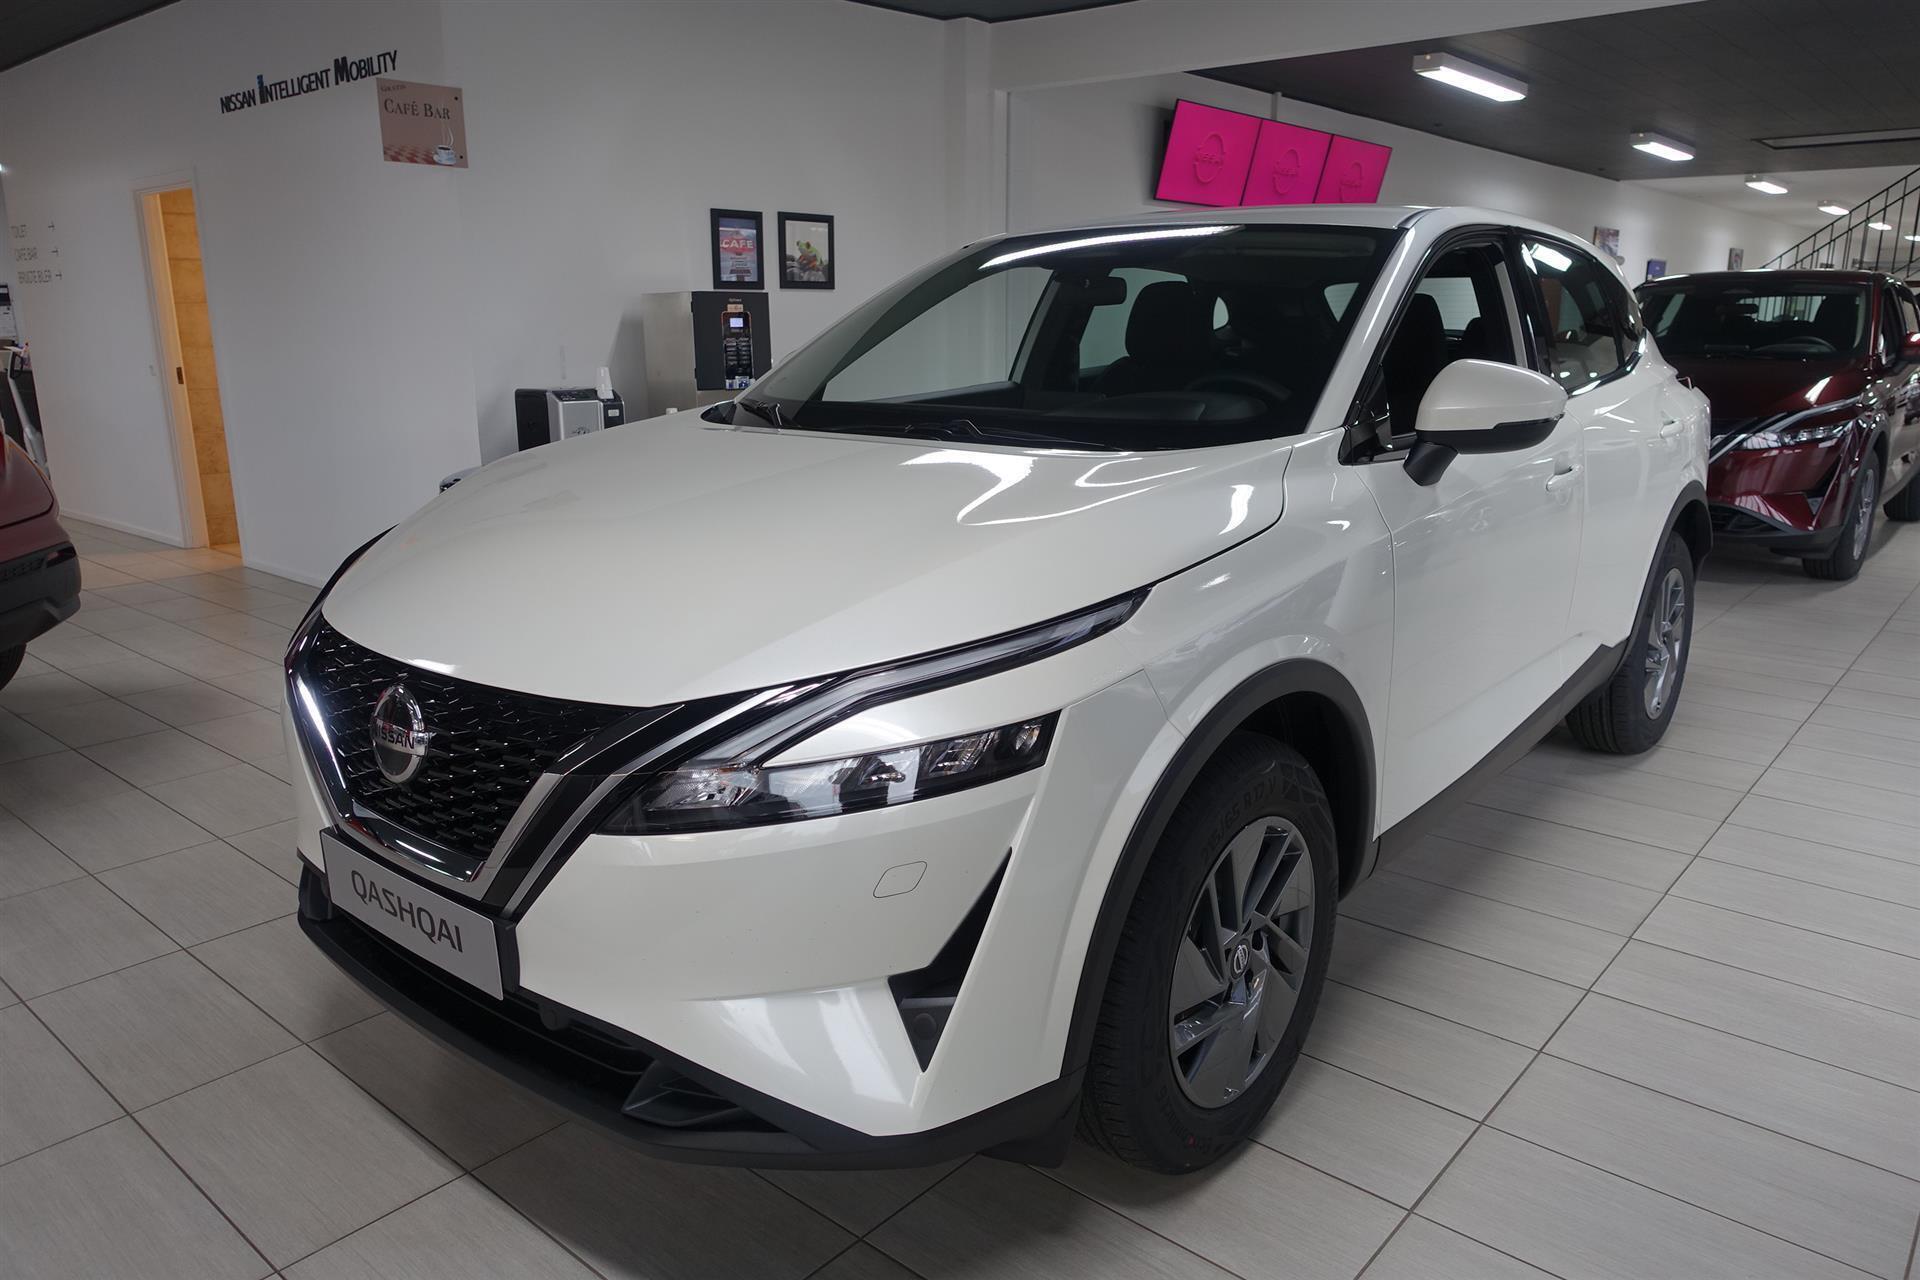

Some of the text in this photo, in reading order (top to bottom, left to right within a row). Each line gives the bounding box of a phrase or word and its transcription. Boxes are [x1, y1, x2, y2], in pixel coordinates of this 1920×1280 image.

[220, 50, 397, 114] NISSAN INTELLIGENT MOBILITY
[423, 103, 451, 120] BAR
[351, 870, 463, 953] QASHQAI
